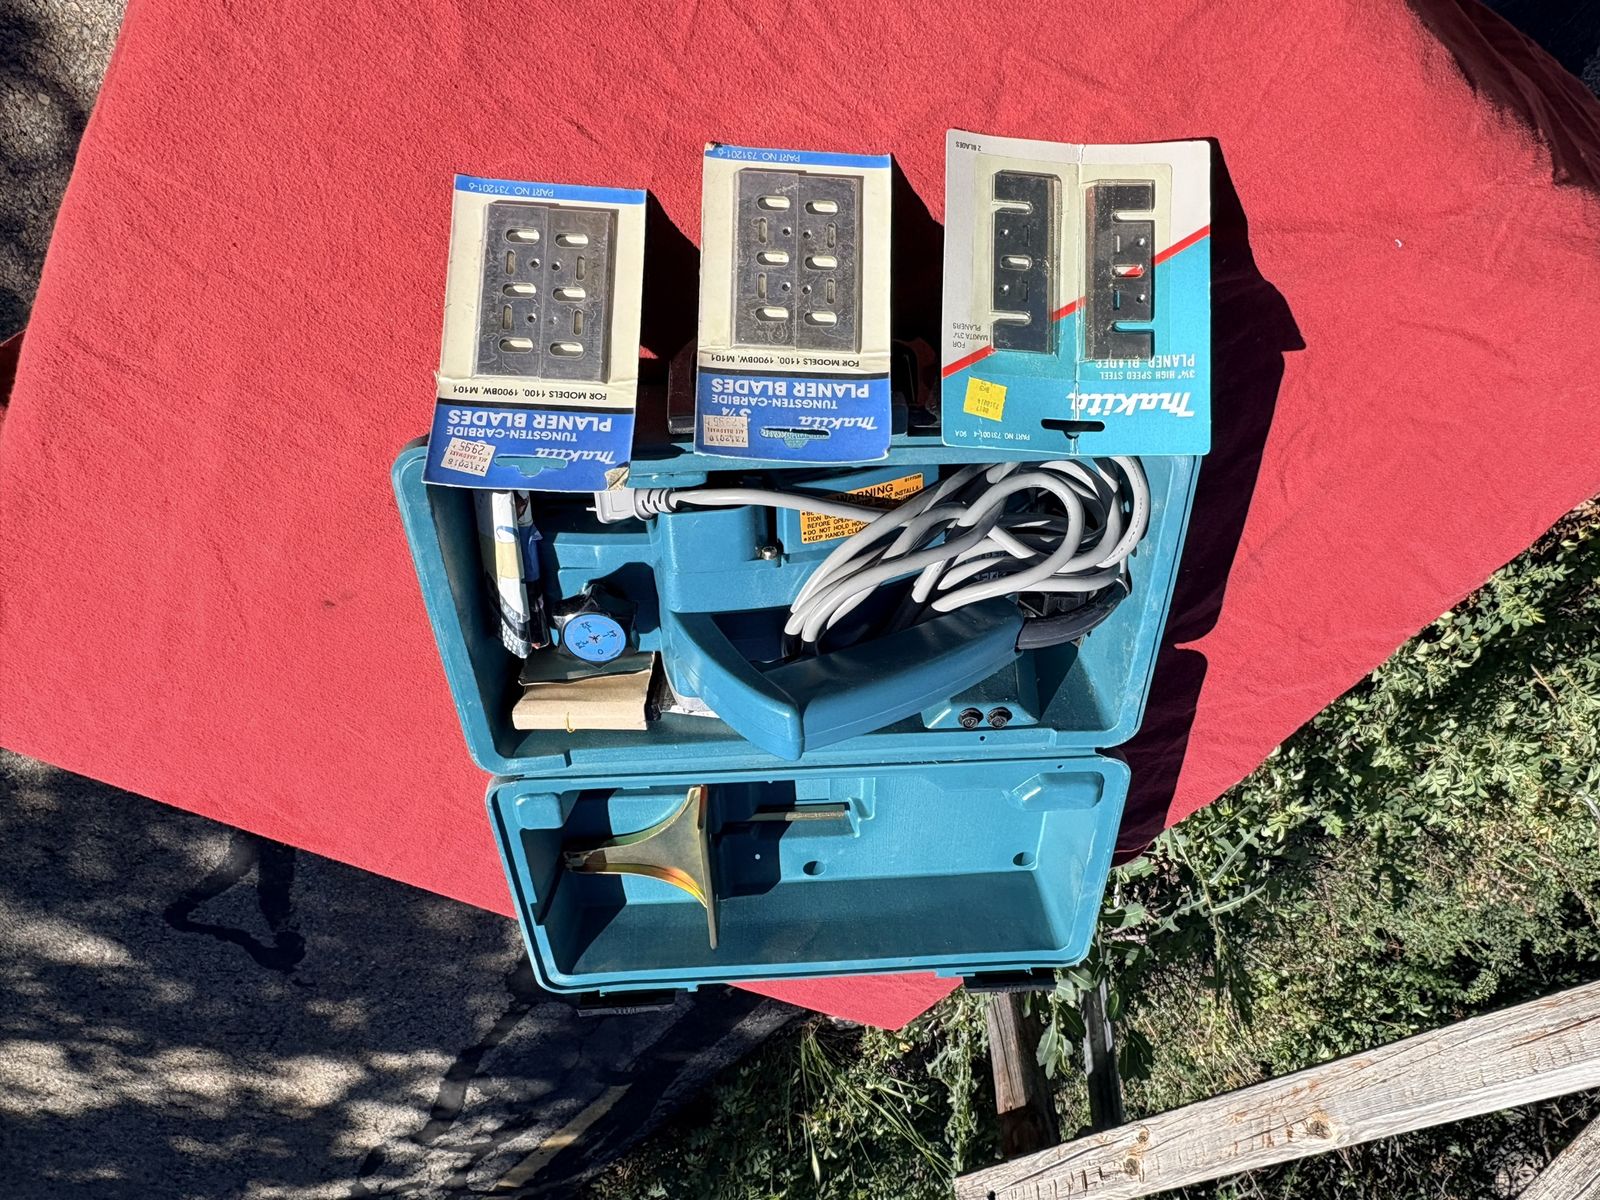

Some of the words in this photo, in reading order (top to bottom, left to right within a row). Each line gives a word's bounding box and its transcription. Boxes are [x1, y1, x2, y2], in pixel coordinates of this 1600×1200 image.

[956, 141, 976, 151] BLADES
[717, 148, 757, 159] 731201-6
[759, 152, 777, 161] NO.
[779, 153, 800, 162] PART
[469, 182, 510, 194] 731201-6
[512, 186, 530, 195] NO.
[532, 188, 554, 196] PART
[952, 322, 981, 331] PLANERS
[965, 332, 988, 341] MAKITA
[952, 340, 966, 348] FOR
[711, 354, 735, 362] M101
[738, 355, 774, 364] 1900BW,
[777, 357, 800, 365] 1100,
[803, 358, 840, 367] MODELS
[1148, 353, 1195, 367] PLANER
[1099, 371, 1123, 380] STEEL
[1126, 371, 1152, 379] SPEED
[1156, 371, 1175, 379] HIGH
[453, 385, 479, 394] M101
[711, 378, 786, 395] BLADES
[793, 381, 869, 398] PLANER
[481, 386, 518, 397] 1900BW,
[522, 388, 546, 397] 1100,
[548, 390, 587, 399] MODELS
[589, 392, 607, 400] FOR
[711, 394, 837, 410] TUNGSTEN-CARBIDE
[447, 409, 527, 427] BLADES
[533, 413, 612, 432] PLANER
[446, 425, 577, 442] TUNGSTEN-CARBIDE
[1018, 433, 1030, 441] PART
[834, 523, 849, 531] HOLD
